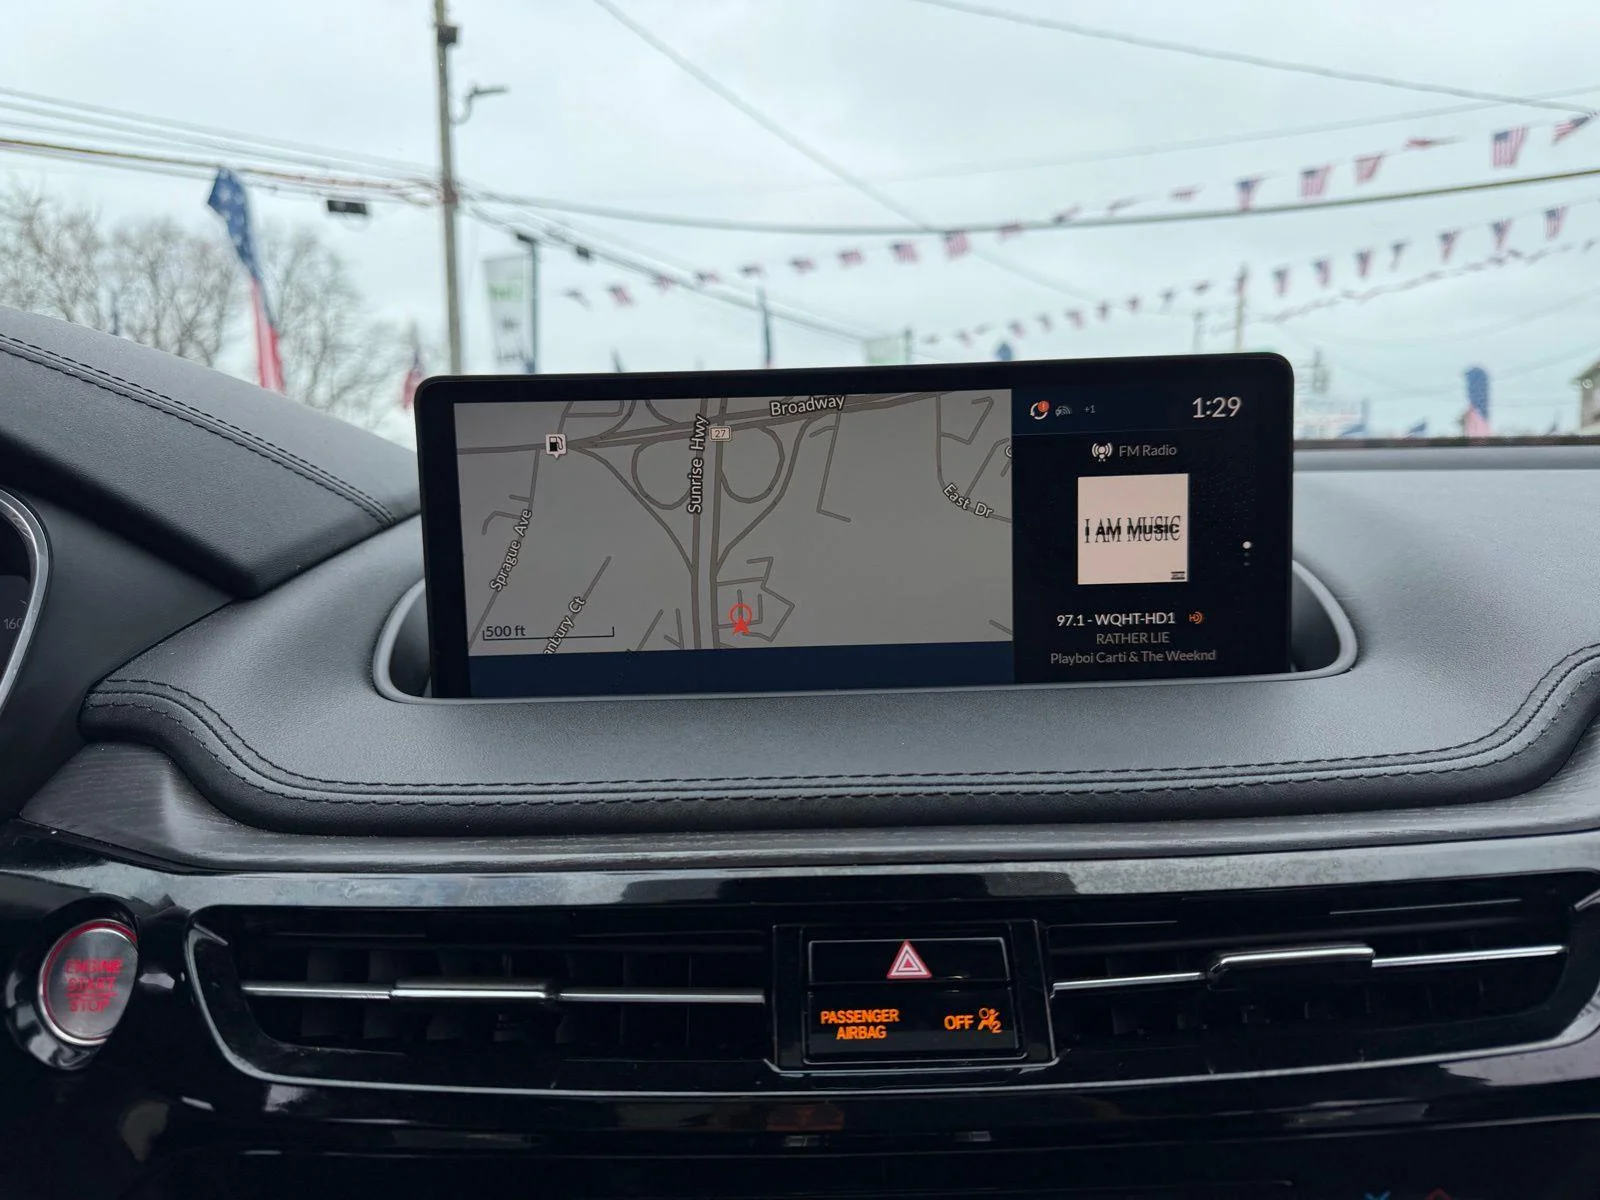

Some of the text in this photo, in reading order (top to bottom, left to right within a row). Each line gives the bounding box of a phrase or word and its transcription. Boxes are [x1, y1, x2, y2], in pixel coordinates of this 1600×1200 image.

[770, 395, 845, 416] Broadway
[1083, 404, 1096, 414] +1
[1192, 396, 1242, 418] 1:29
[714, 429, 727, 439] 27
[1119, 444, 1177, 457] FM Radio
[687, 415, 709, 514] Sunrise Hwy
[943, 483, 994, 518] East Dr
[1094, 517, 1121, 543] AM
[1126, 515, 1181, 542] MUSIC
[490, 509, 532, 592] Sprague Ave
[568, 596, 586, 614] Ct
[1056, 614, 1085, 627] 97.1
[1095, 612, 1176, 625] WQHT-HD1
[485, 625, 526, 637] 500 ft
[1096, 632, 1170, 645] RATHER LIE
[1050, 649, 1216, 666] Playboi Carti & The Weeknd
[65, 959, 123, 974] ENGINE
[820, 1008, 900, 1024] PASSENGER
[944, 1014, 974, 1030] OFF
[835, 1025, 887, 1040] AIRBAG
